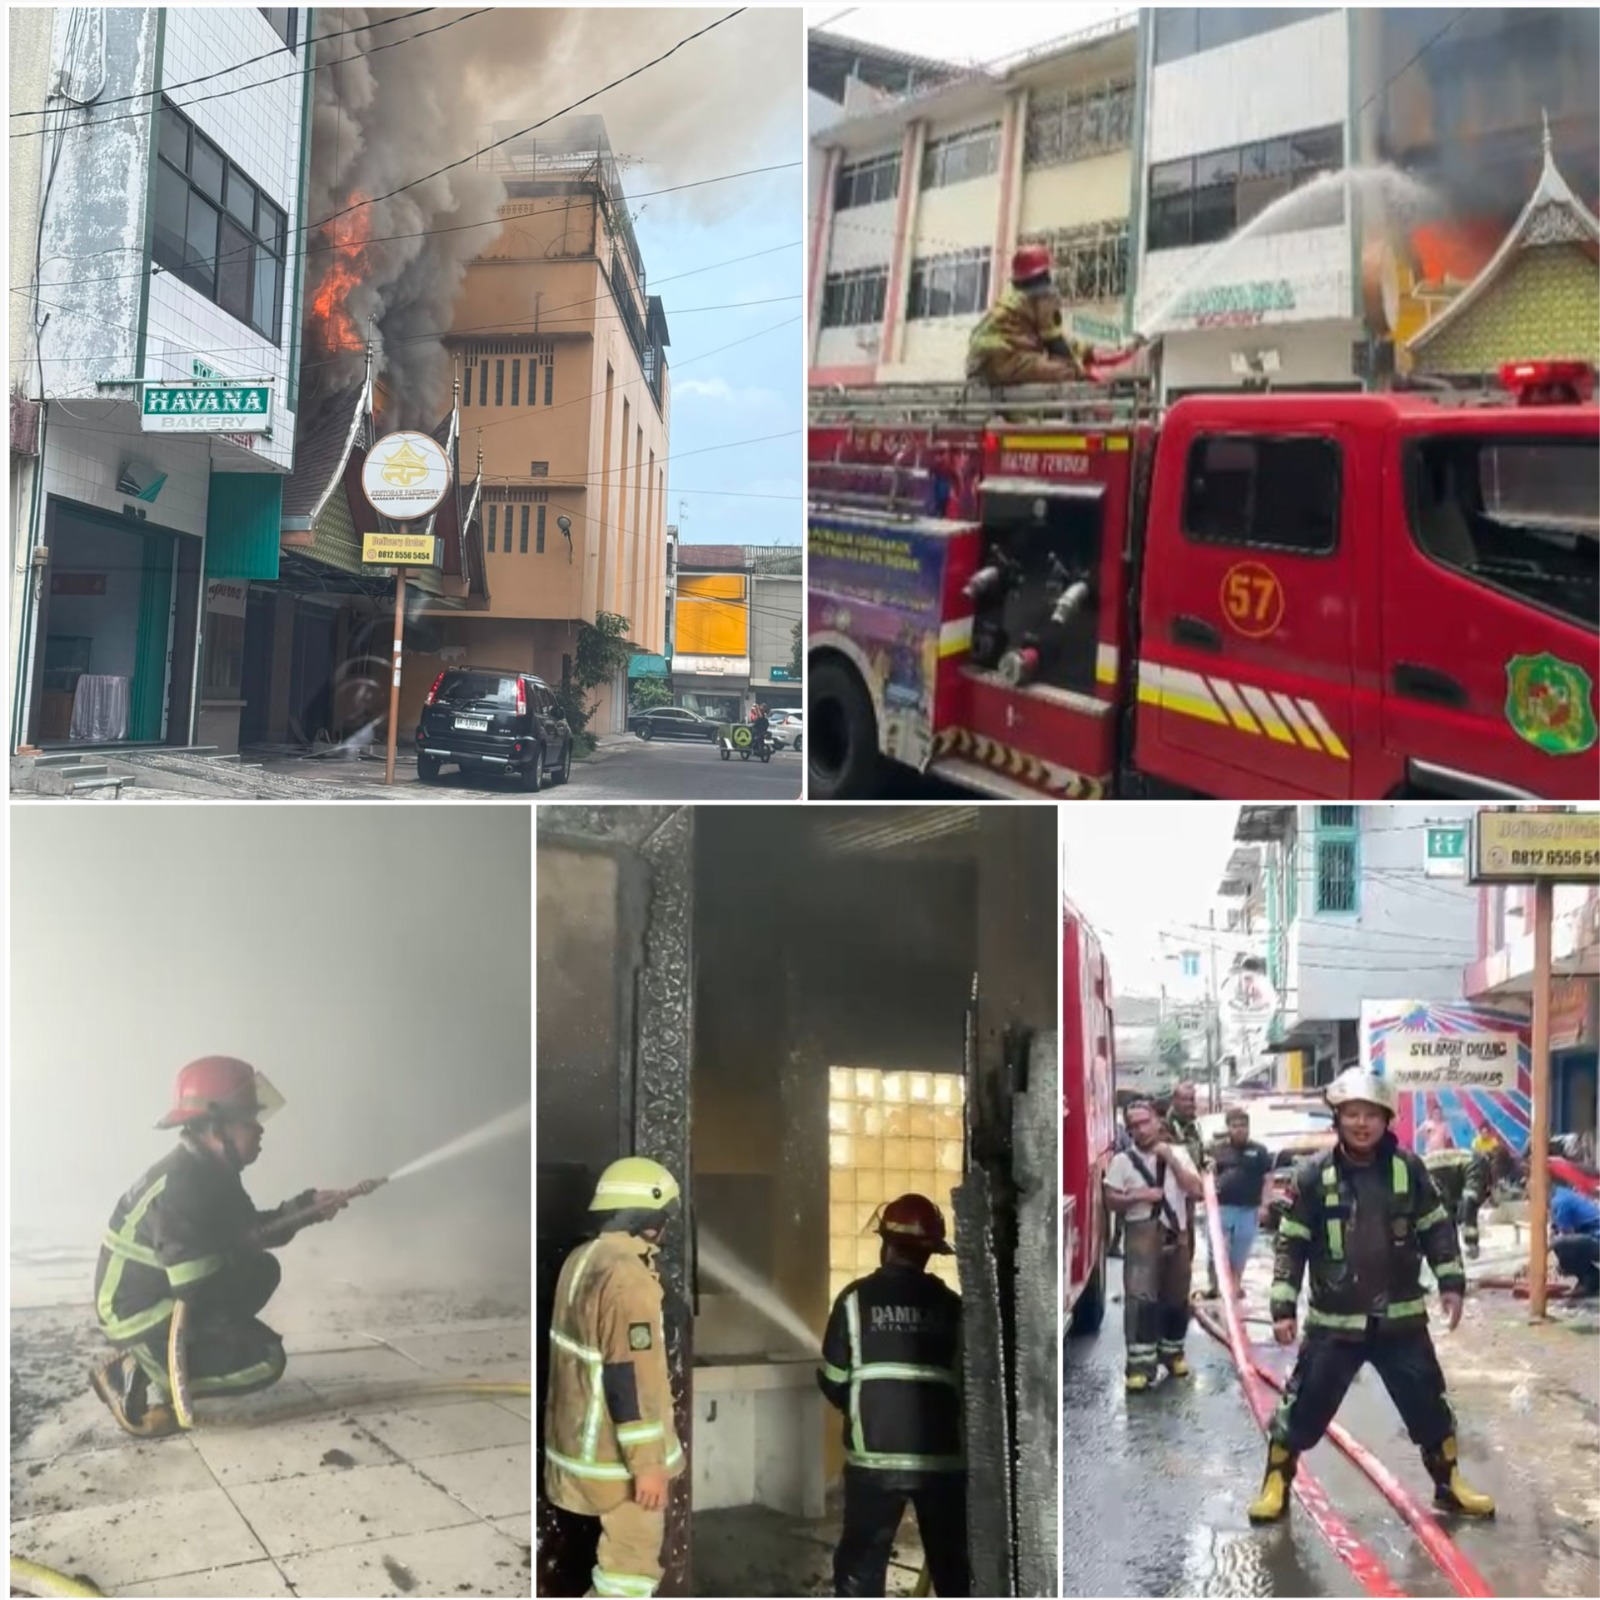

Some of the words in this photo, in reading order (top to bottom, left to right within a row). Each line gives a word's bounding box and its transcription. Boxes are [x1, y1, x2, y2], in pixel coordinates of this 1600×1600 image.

[147, 389, 263, 413] HAVANA
[160, 416, 248, 429] BAKERY
[371, 535, 404, 547] Delivery
[378, 550, 394, 559] 0812
[394, 551, 412, 560] 6556
[412, 552, 430, 560] 5454
[1228, 574, 1275, 620] 57
[1511, 849, 1544, 866] 0812
[1546, 849, 1582, 866] 6556
